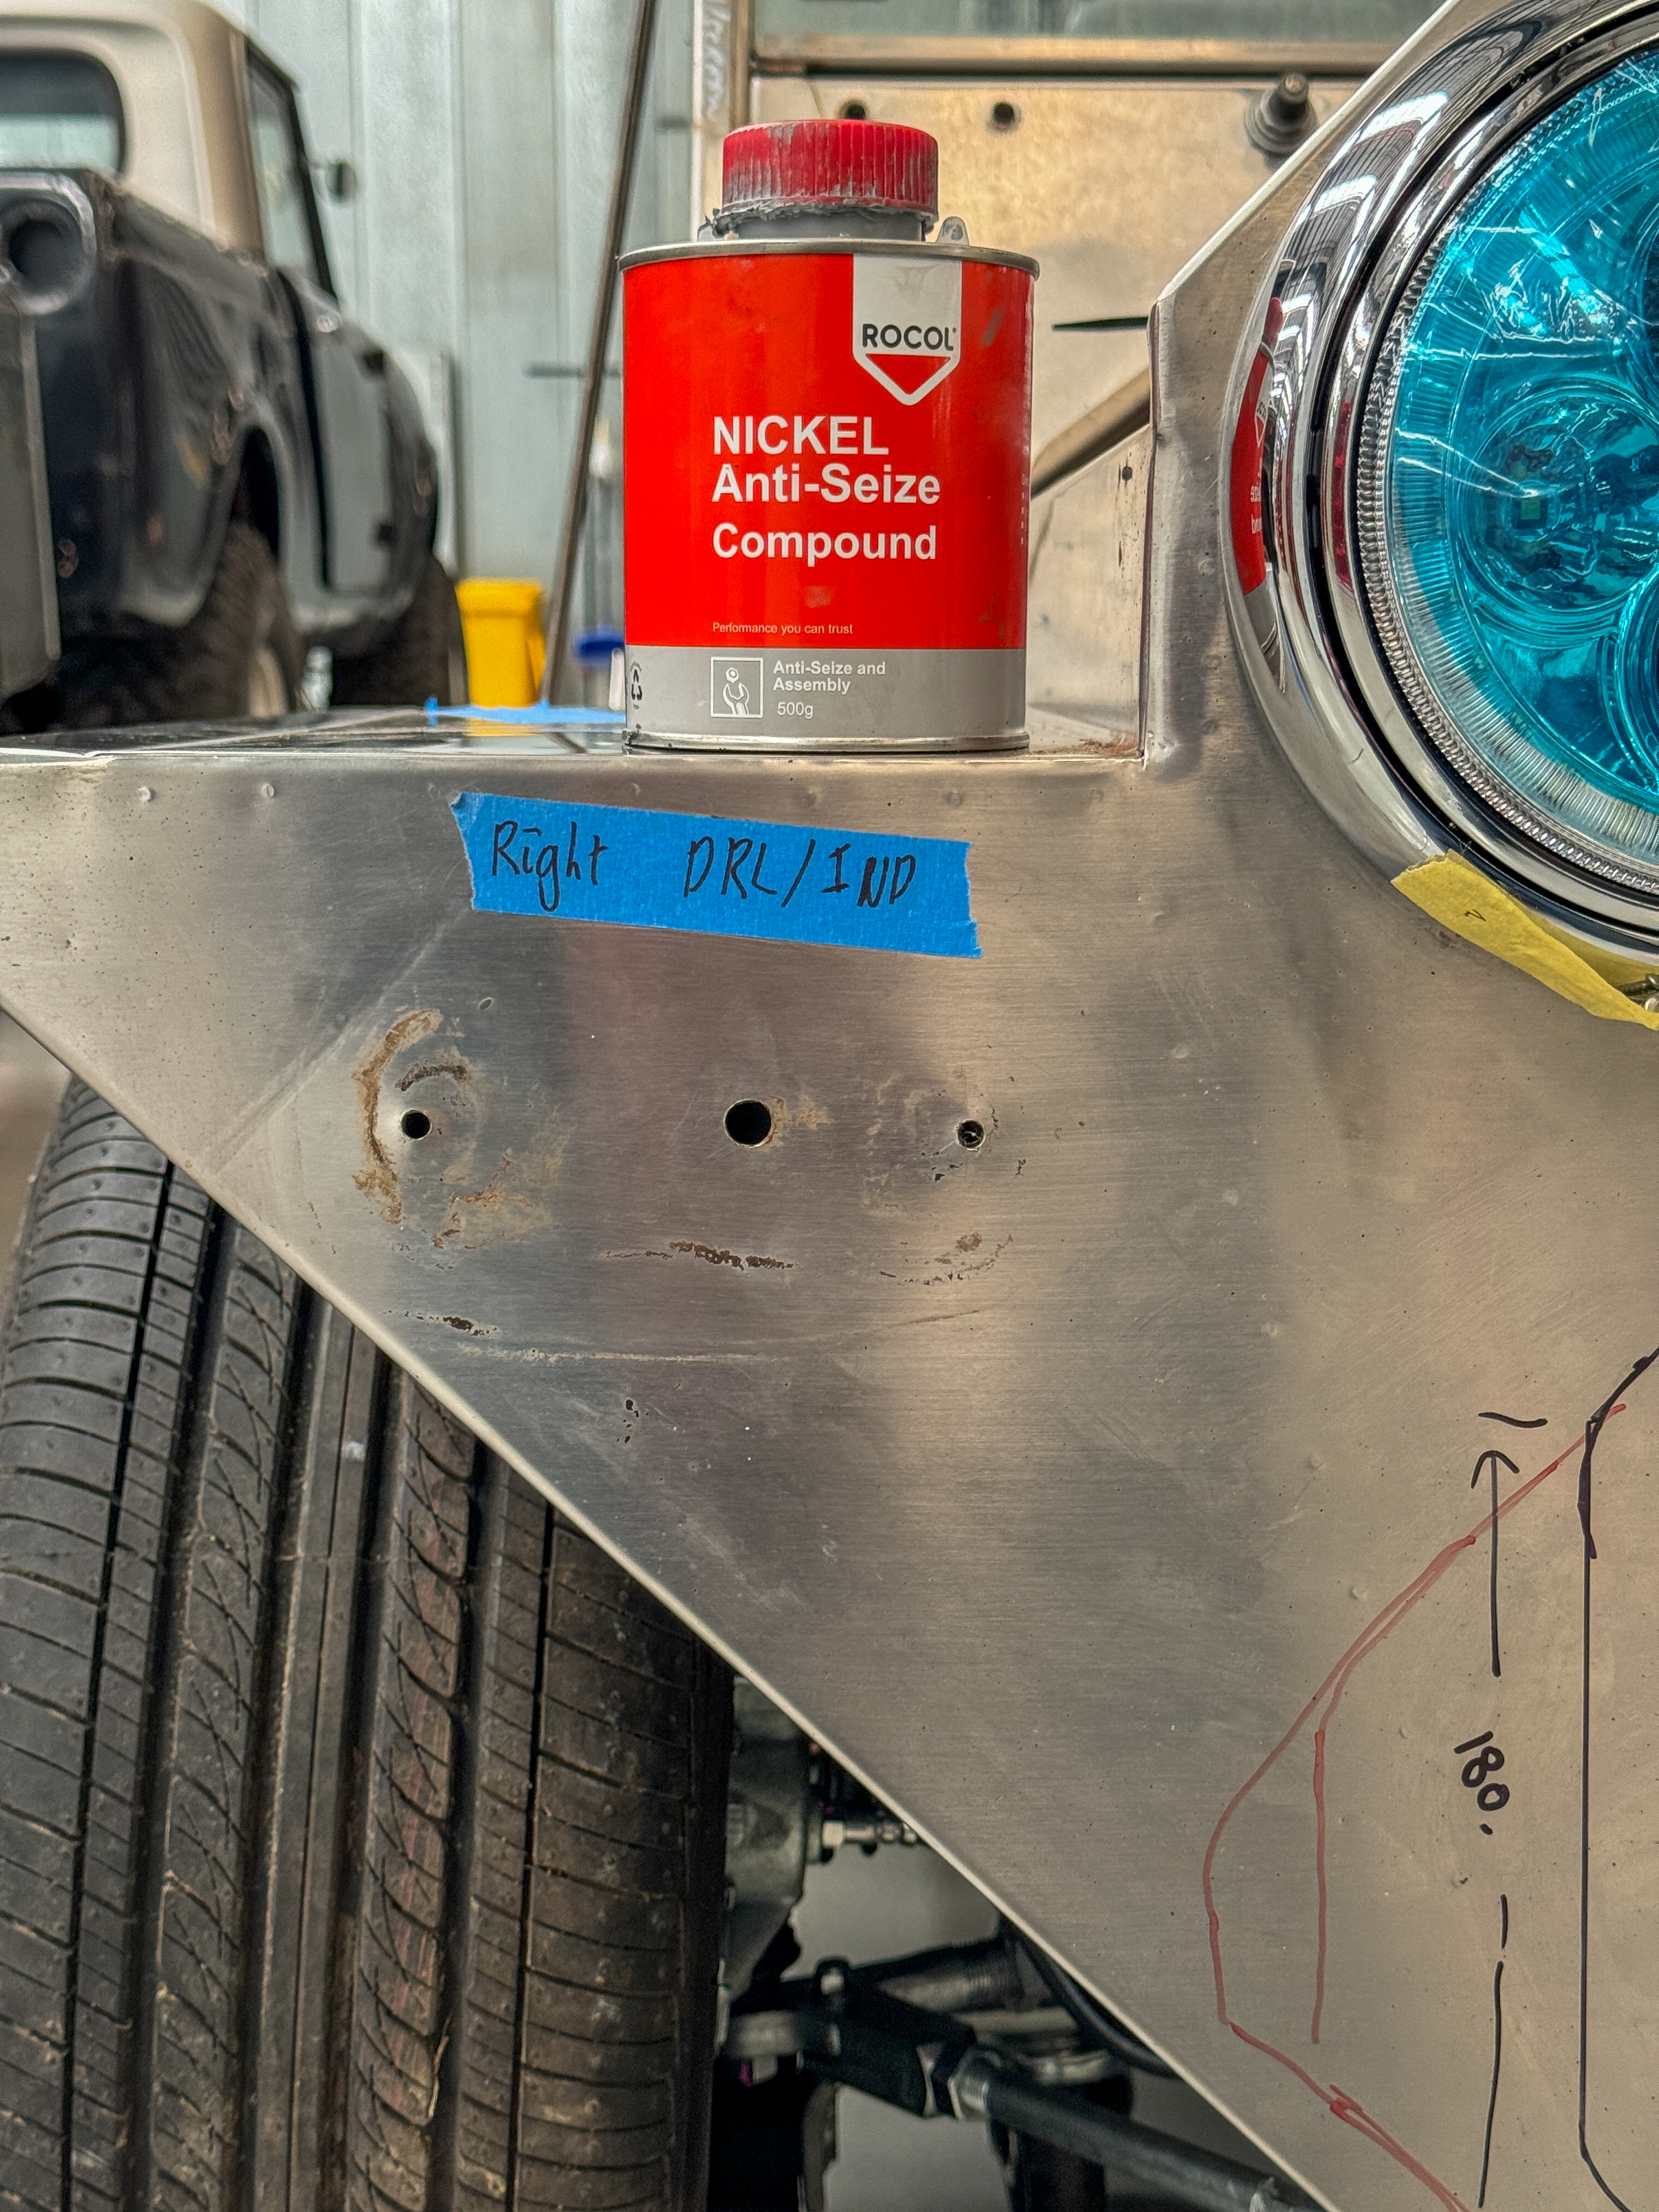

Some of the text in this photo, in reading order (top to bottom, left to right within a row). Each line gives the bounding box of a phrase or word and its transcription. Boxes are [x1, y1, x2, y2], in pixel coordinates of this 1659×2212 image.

[862, 323, 954, 352] ROCOL
[713, 415, 889, 456] NICKEL
[711, 463, 941, 505] Anti-Seize
[712, 523, 937, 567] Compound
[712, 622, 854, 636] Performance you can trust
[773, 660, 886, 675] Anti-Seize and
[773, 677, 851, 695] Assembly
[777, 701, 813, 719] 500g
[492, 820, 608, 912] Right
